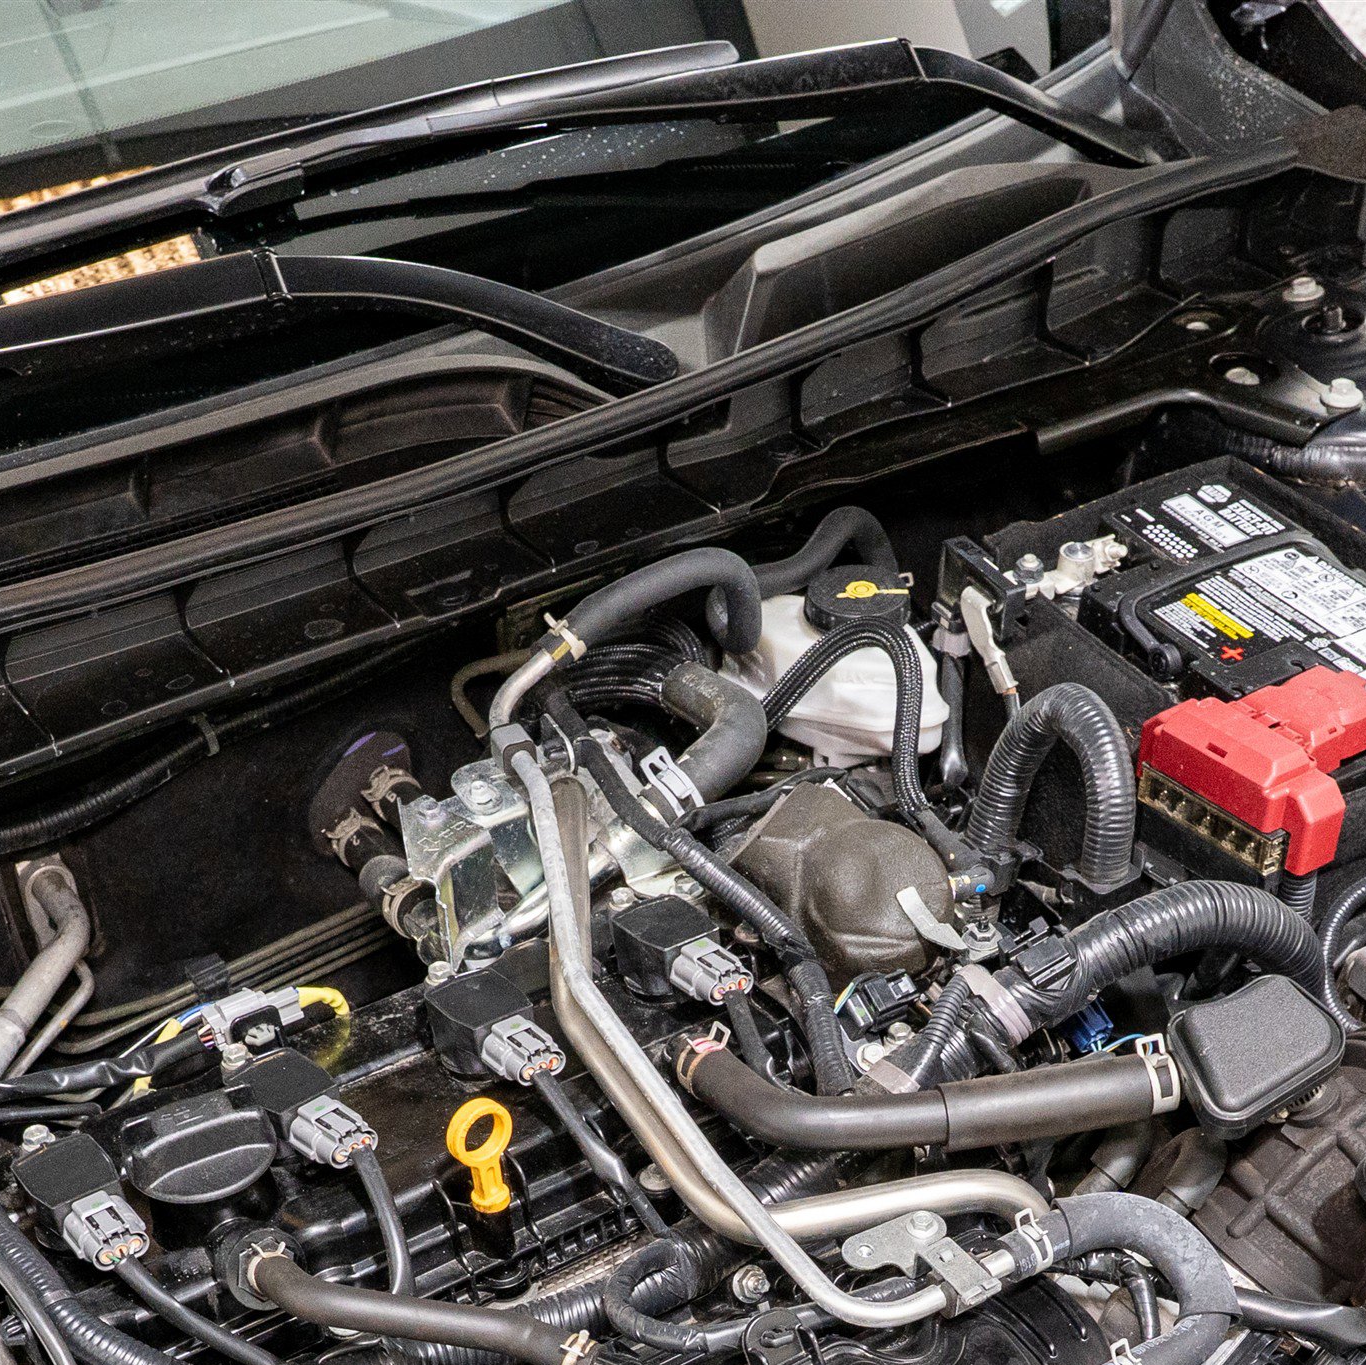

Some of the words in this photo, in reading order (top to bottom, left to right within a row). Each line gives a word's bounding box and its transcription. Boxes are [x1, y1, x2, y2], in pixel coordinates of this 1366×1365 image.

[1175, 503, 1228, 540] TECHNOLOGY
[1195, 509, 1225, 529] AGM
[1217, 508, 1264, 536] BATTERY
[1227, 501, 1279, 535] EXACT-FIT
